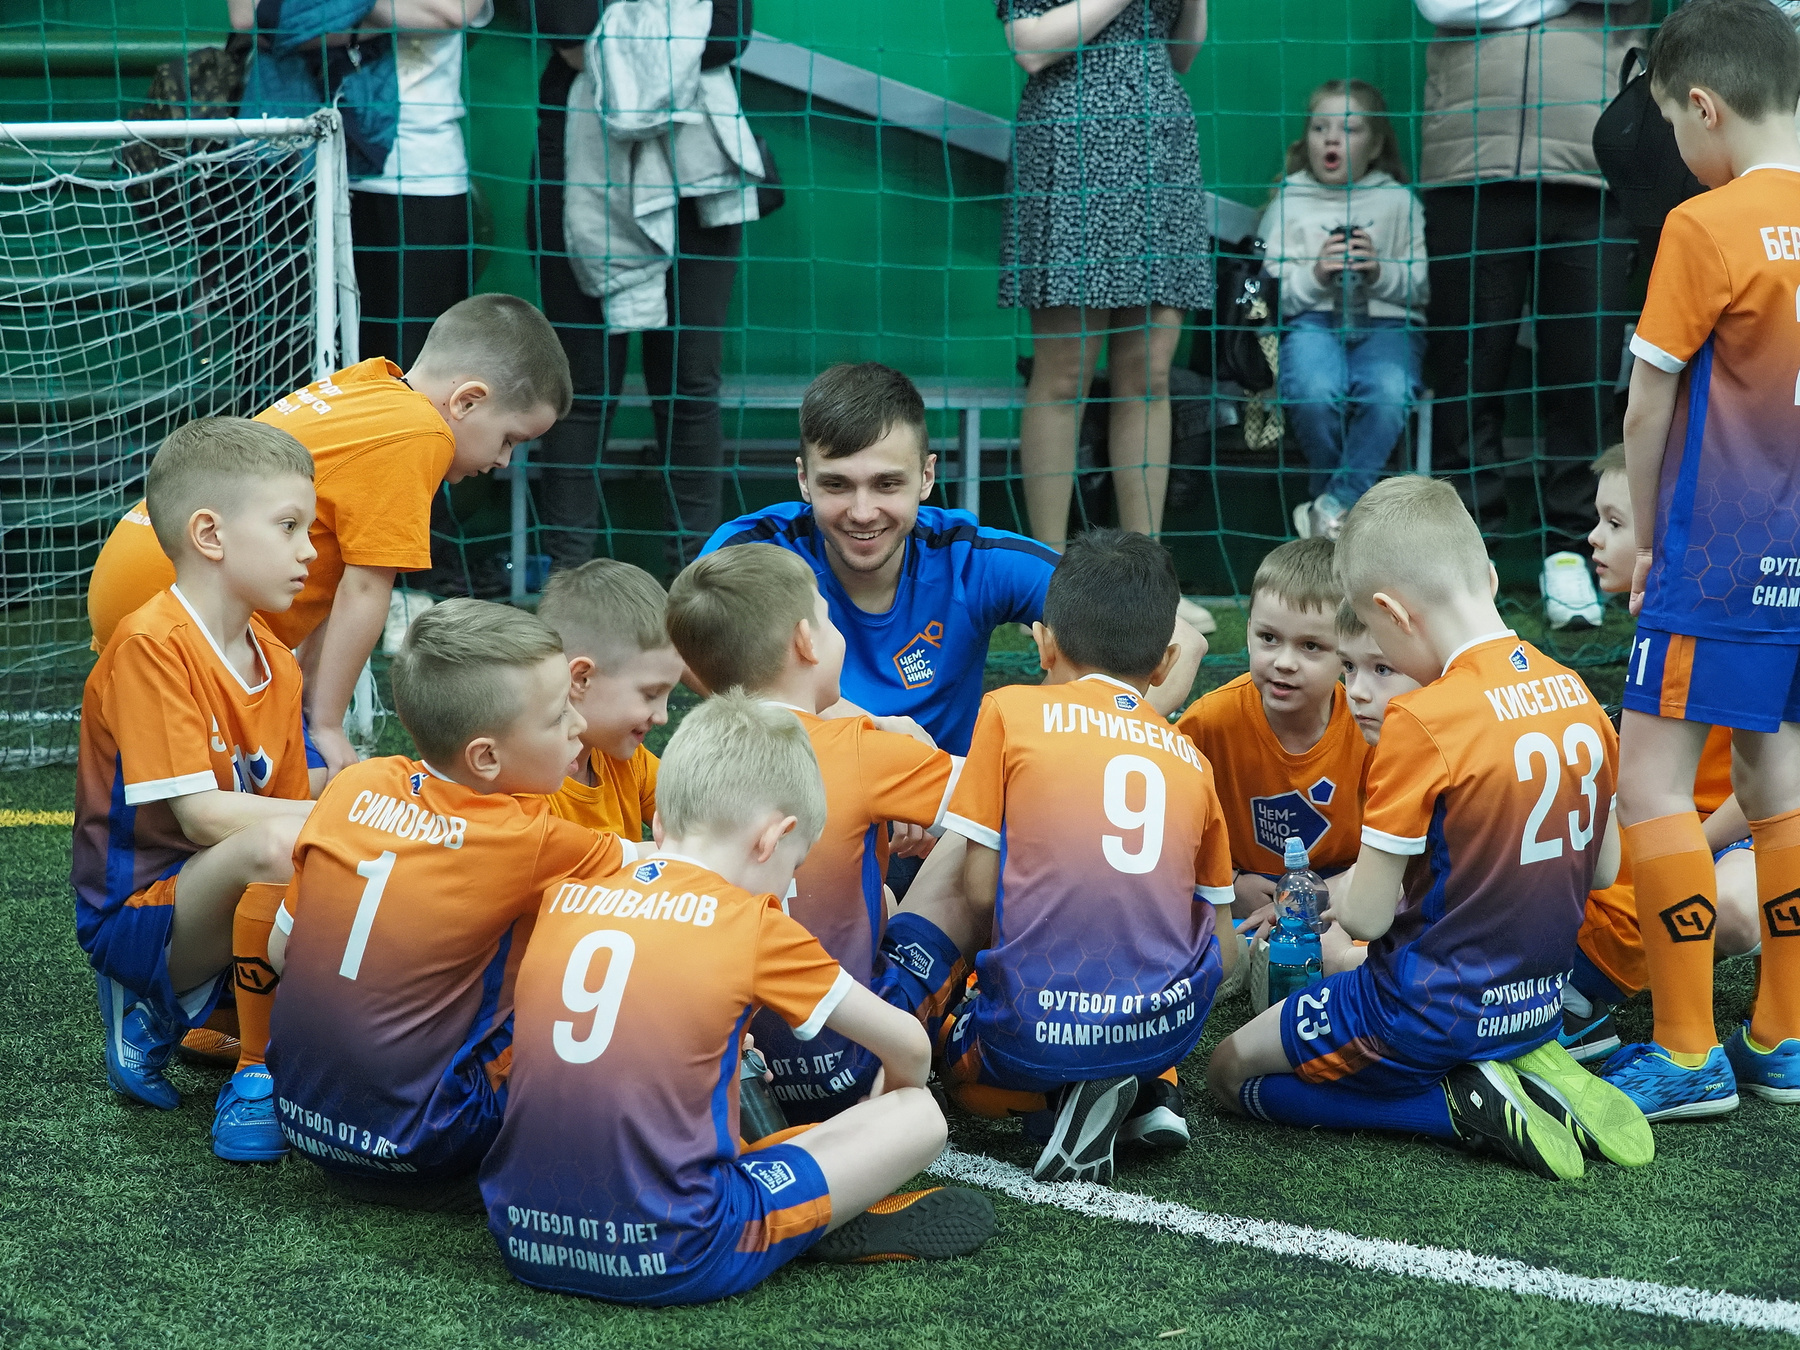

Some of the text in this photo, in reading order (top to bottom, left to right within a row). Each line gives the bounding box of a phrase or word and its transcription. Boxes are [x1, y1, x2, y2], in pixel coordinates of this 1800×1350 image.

[900, 649, 925, 666] ЧЕМ-
[903, 659, 931, 675] ПИО-
[907, 668, 934, 682] НИКА
[1626, 634, 1651, 686] 1
[1484, 674, 1589, 722] КИСЕЛЕВ
[1043, 702, 1203, 773] ИЛЧИБЕКОВ
[1101, 754, 1167, 875] 9
[1258, 803, 1297, 821] ЧЕМ-
[1513, 722, 1604, 866] 23
[348, 789, 468, 850] СИМОНОВ
[1258, 817, 1300, 837] ПИО-
[339, 850, 397, 981] 1
[549, 883, 718, 927] ГОЛОВАНОВ
[552, 929, 636, 1065] 9
[1038, 989, 1117, 1014] ФУТБОЛ
[1122, 995, 1145, 1014] ОТ
[1150, 993, 1161, 1012] 3
[1162, 977, 1193, 1007] ЛЕТ
[1297, 987, 1332, 1042] 23
[1481, 979, 1534, 1006] ФУТБОЛ
[1035, 1001, 1195, 1045] CHAMPIONIKA.RU
[772, 1050, 844, 1076] ОТ 3 ЛЕТ
[1705, 1082, 1725, 1091] SPORT
[279, 1096, 399, 1159] ФУТБОЛ ОТ 3 ЛЕТ
[507, 1204, 658, 1244] ФУТБОЛ ОТ 3 ЛЕТ
[507, 1236, 668, 1277] CHAMPIONIKA.RU
